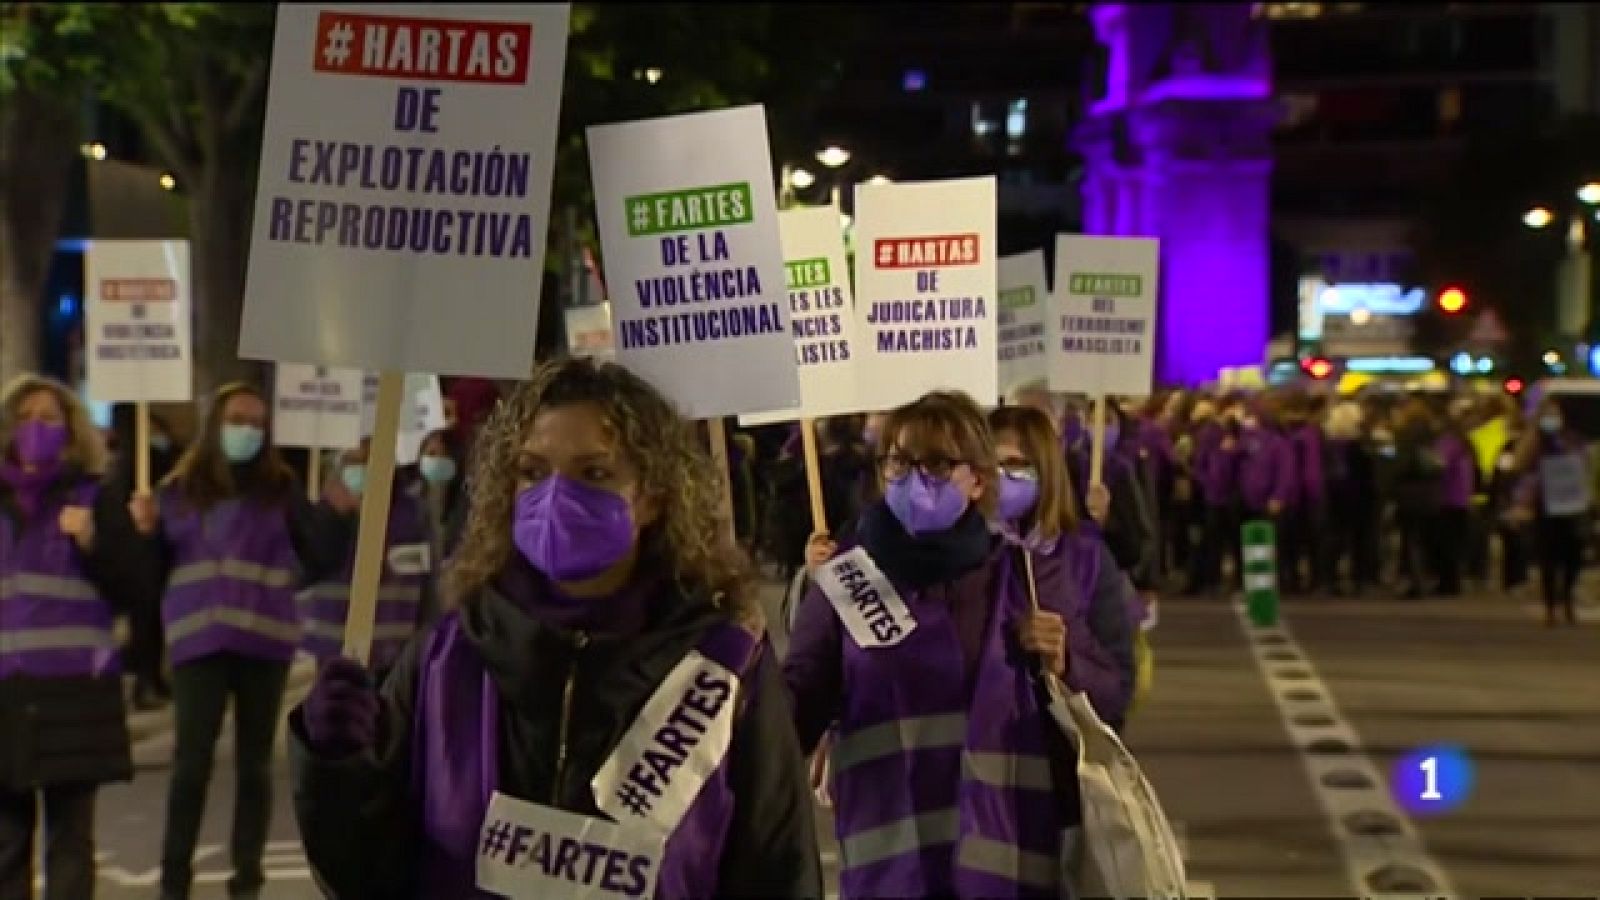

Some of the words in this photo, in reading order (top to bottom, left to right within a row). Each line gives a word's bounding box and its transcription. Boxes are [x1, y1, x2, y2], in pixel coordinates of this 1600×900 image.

[394, 87, 442, 133] DE
[289, 139, 531, 198] EXPLOTACIÓN
[269, 197, 532, 258] REPRODUCTIVA
[660, 235, 690, 266] DE
[697, 231, 730, 262] LA
[916, 271, 939, 293] DE
[620, 302, 785, 349] INSTITUCIONAL
[867, 297, 987, 324] JUDICATURA
[877, 327, 978, 352] MACHISTA
[833, 560, 903, 643] #FARTES
[616, 671, 732, 818] #FARTES
[482, 820, 651, 896] #FARTES
